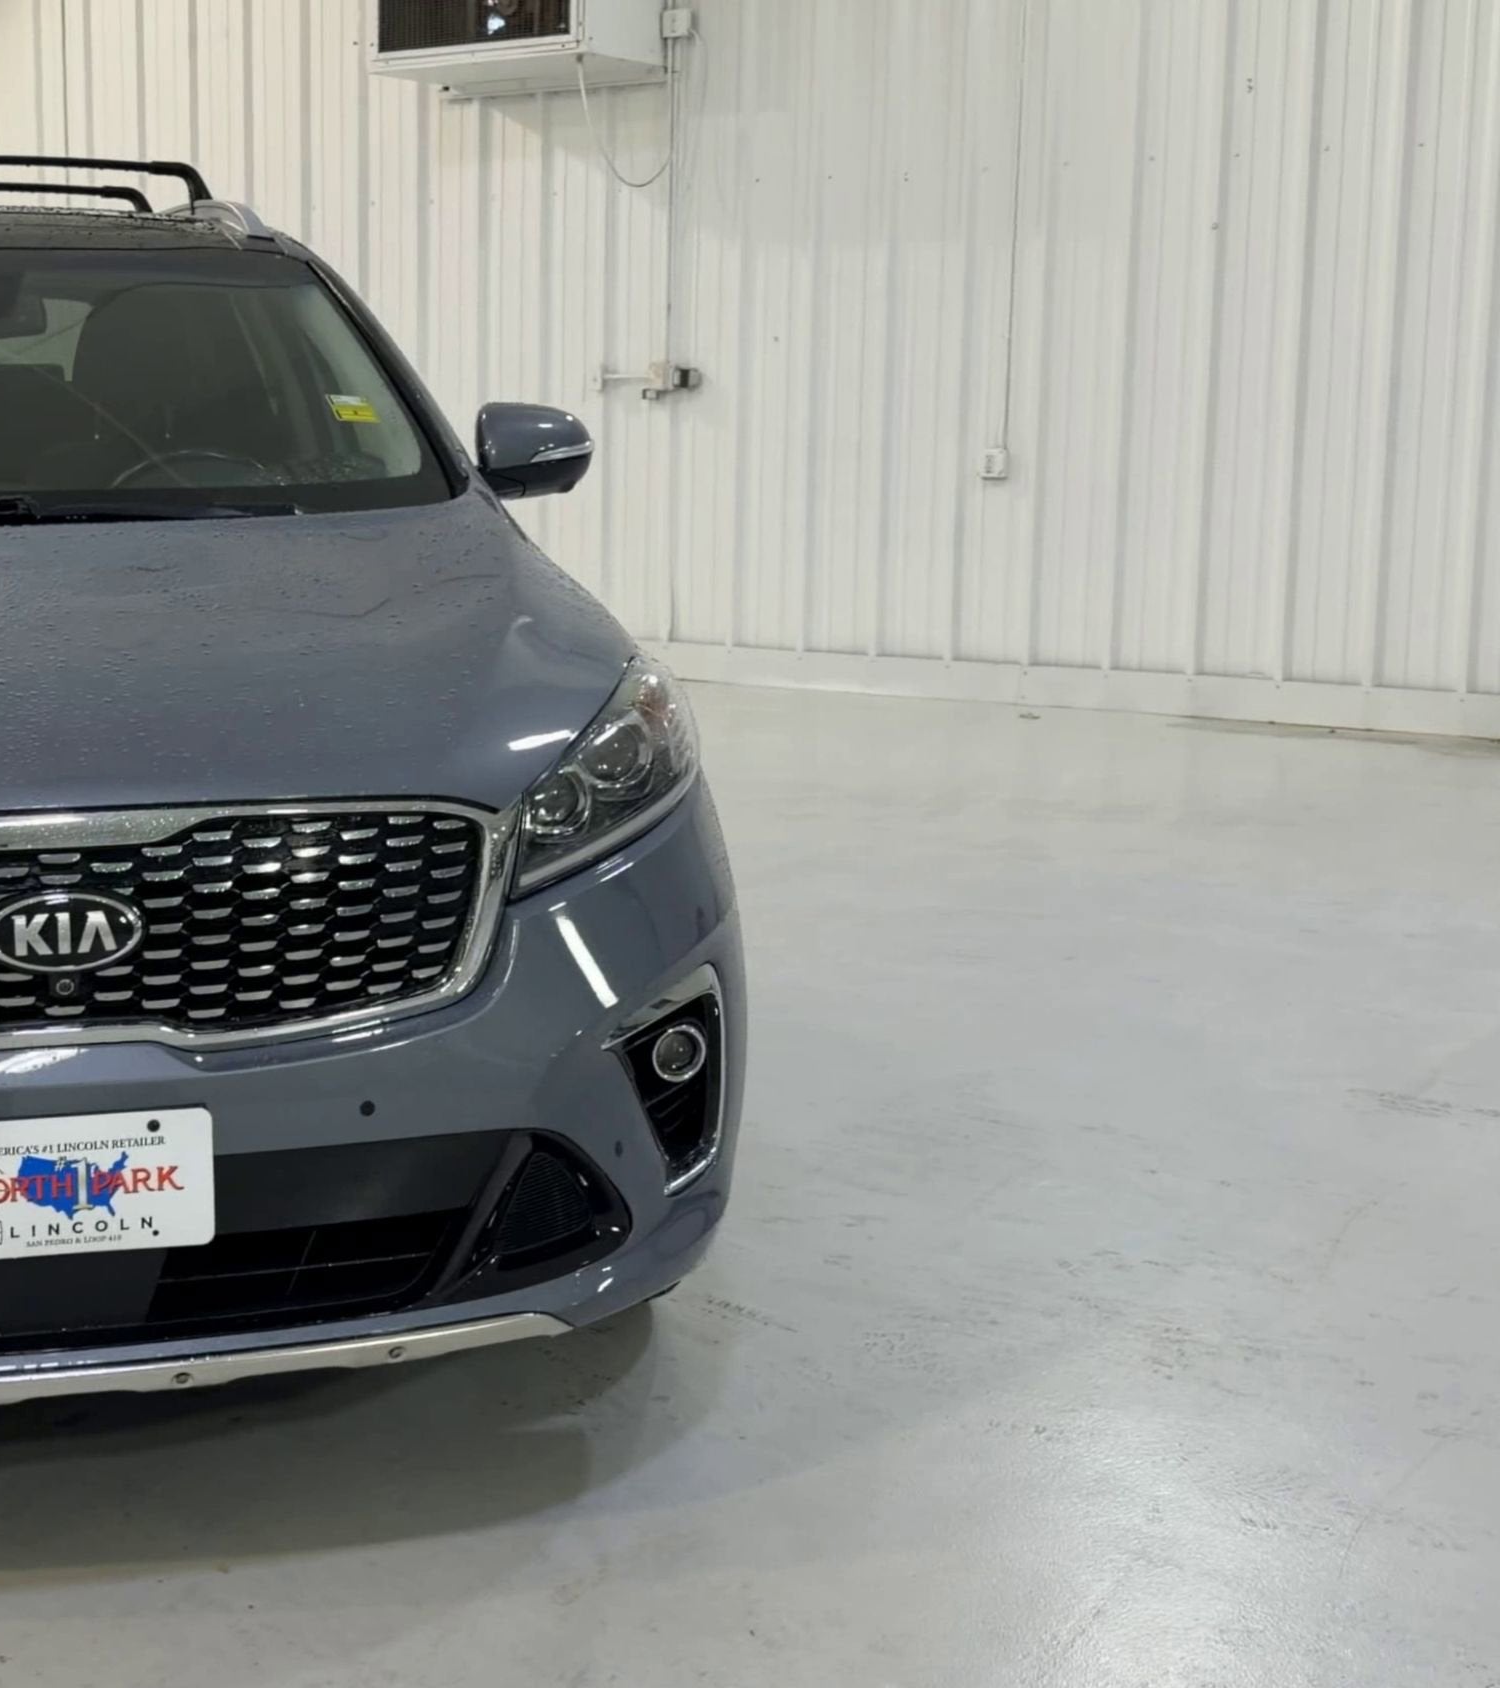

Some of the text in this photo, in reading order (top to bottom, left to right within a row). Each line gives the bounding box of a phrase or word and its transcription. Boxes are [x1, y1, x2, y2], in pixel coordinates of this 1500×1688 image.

[11, 910, 117, 957] KIA
[41, 1143, 55, 1155] #1
[56, 1139, 110, 1154] LINCOLN
[112, 1135, 166, 1150] RETAILER
[92, 1165, 185, 1196] PARK
[9, 1216, 154, 1240] LINCOLN
[26, 1239, 43, 1248] SAN
